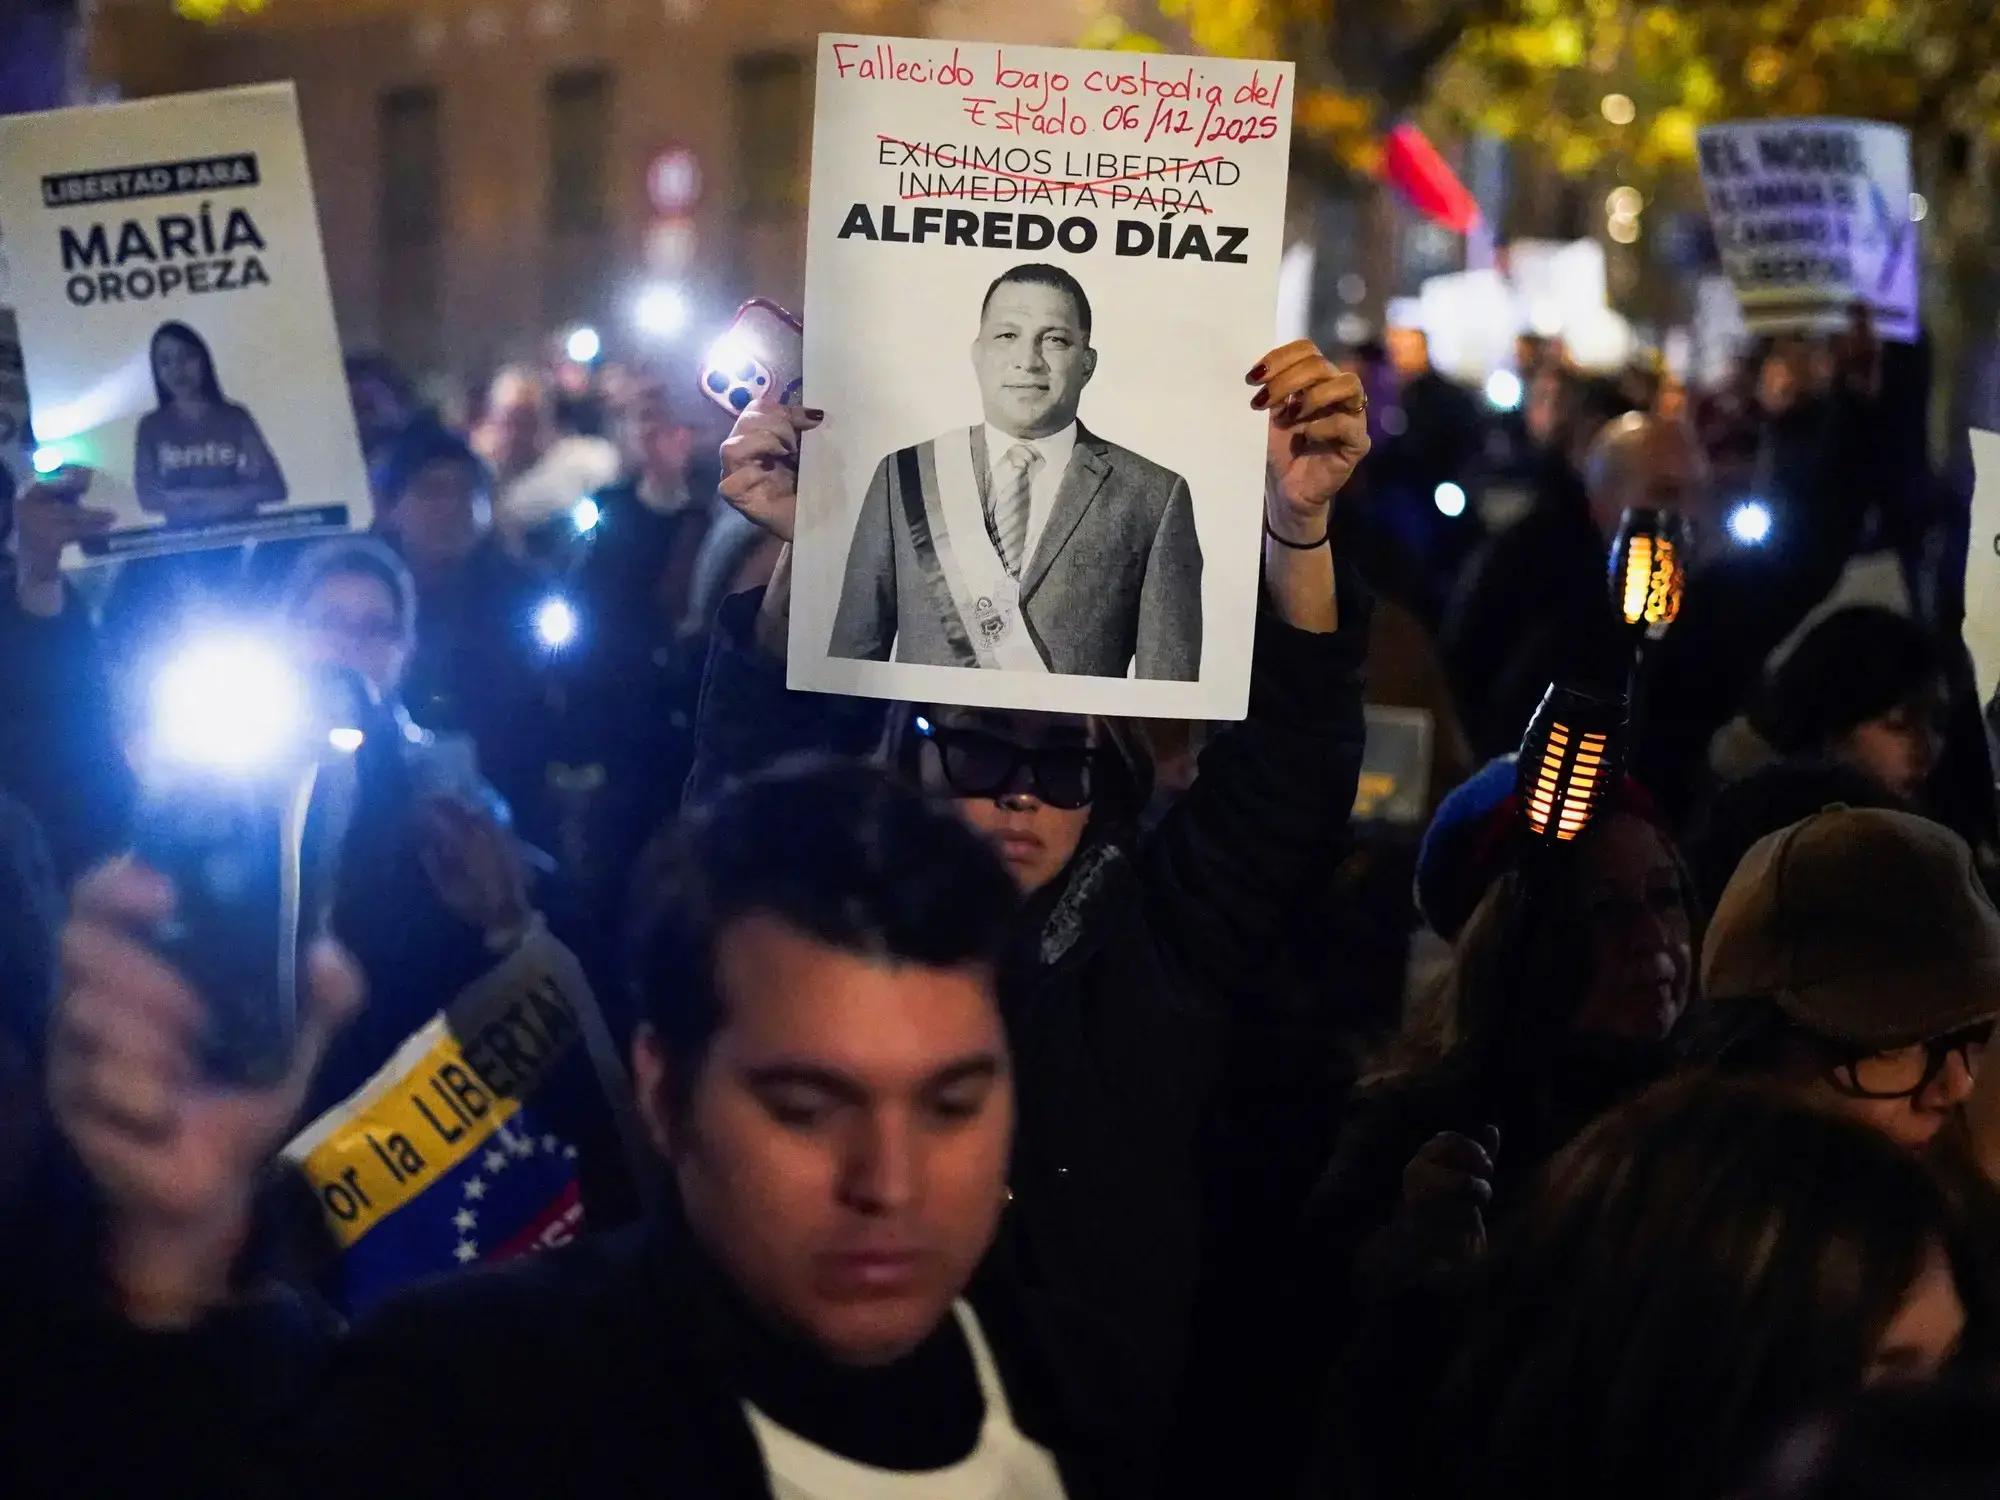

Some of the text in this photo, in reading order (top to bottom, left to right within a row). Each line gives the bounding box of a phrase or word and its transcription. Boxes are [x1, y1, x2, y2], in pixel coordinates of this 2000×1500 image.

[833, 43, 1284, 113] Fallecido bajo custodia del
[1102, 97, 1278, 148] 06/12/2025
[44, 158, 250, 202] LIBERTAD PARA
[879, 139, 1241, 187] EXIGIMOS LIBERTAD
[899, 171, 1208, 216] INMEDIATA PARA
[59, 199, 266, 271] MARÍA
[837, 203, 1250, 264] ALFREDO DÍAZ
[66, 255, 271, 306] OROPEZA
[365, 1132, 426, 1184] la
